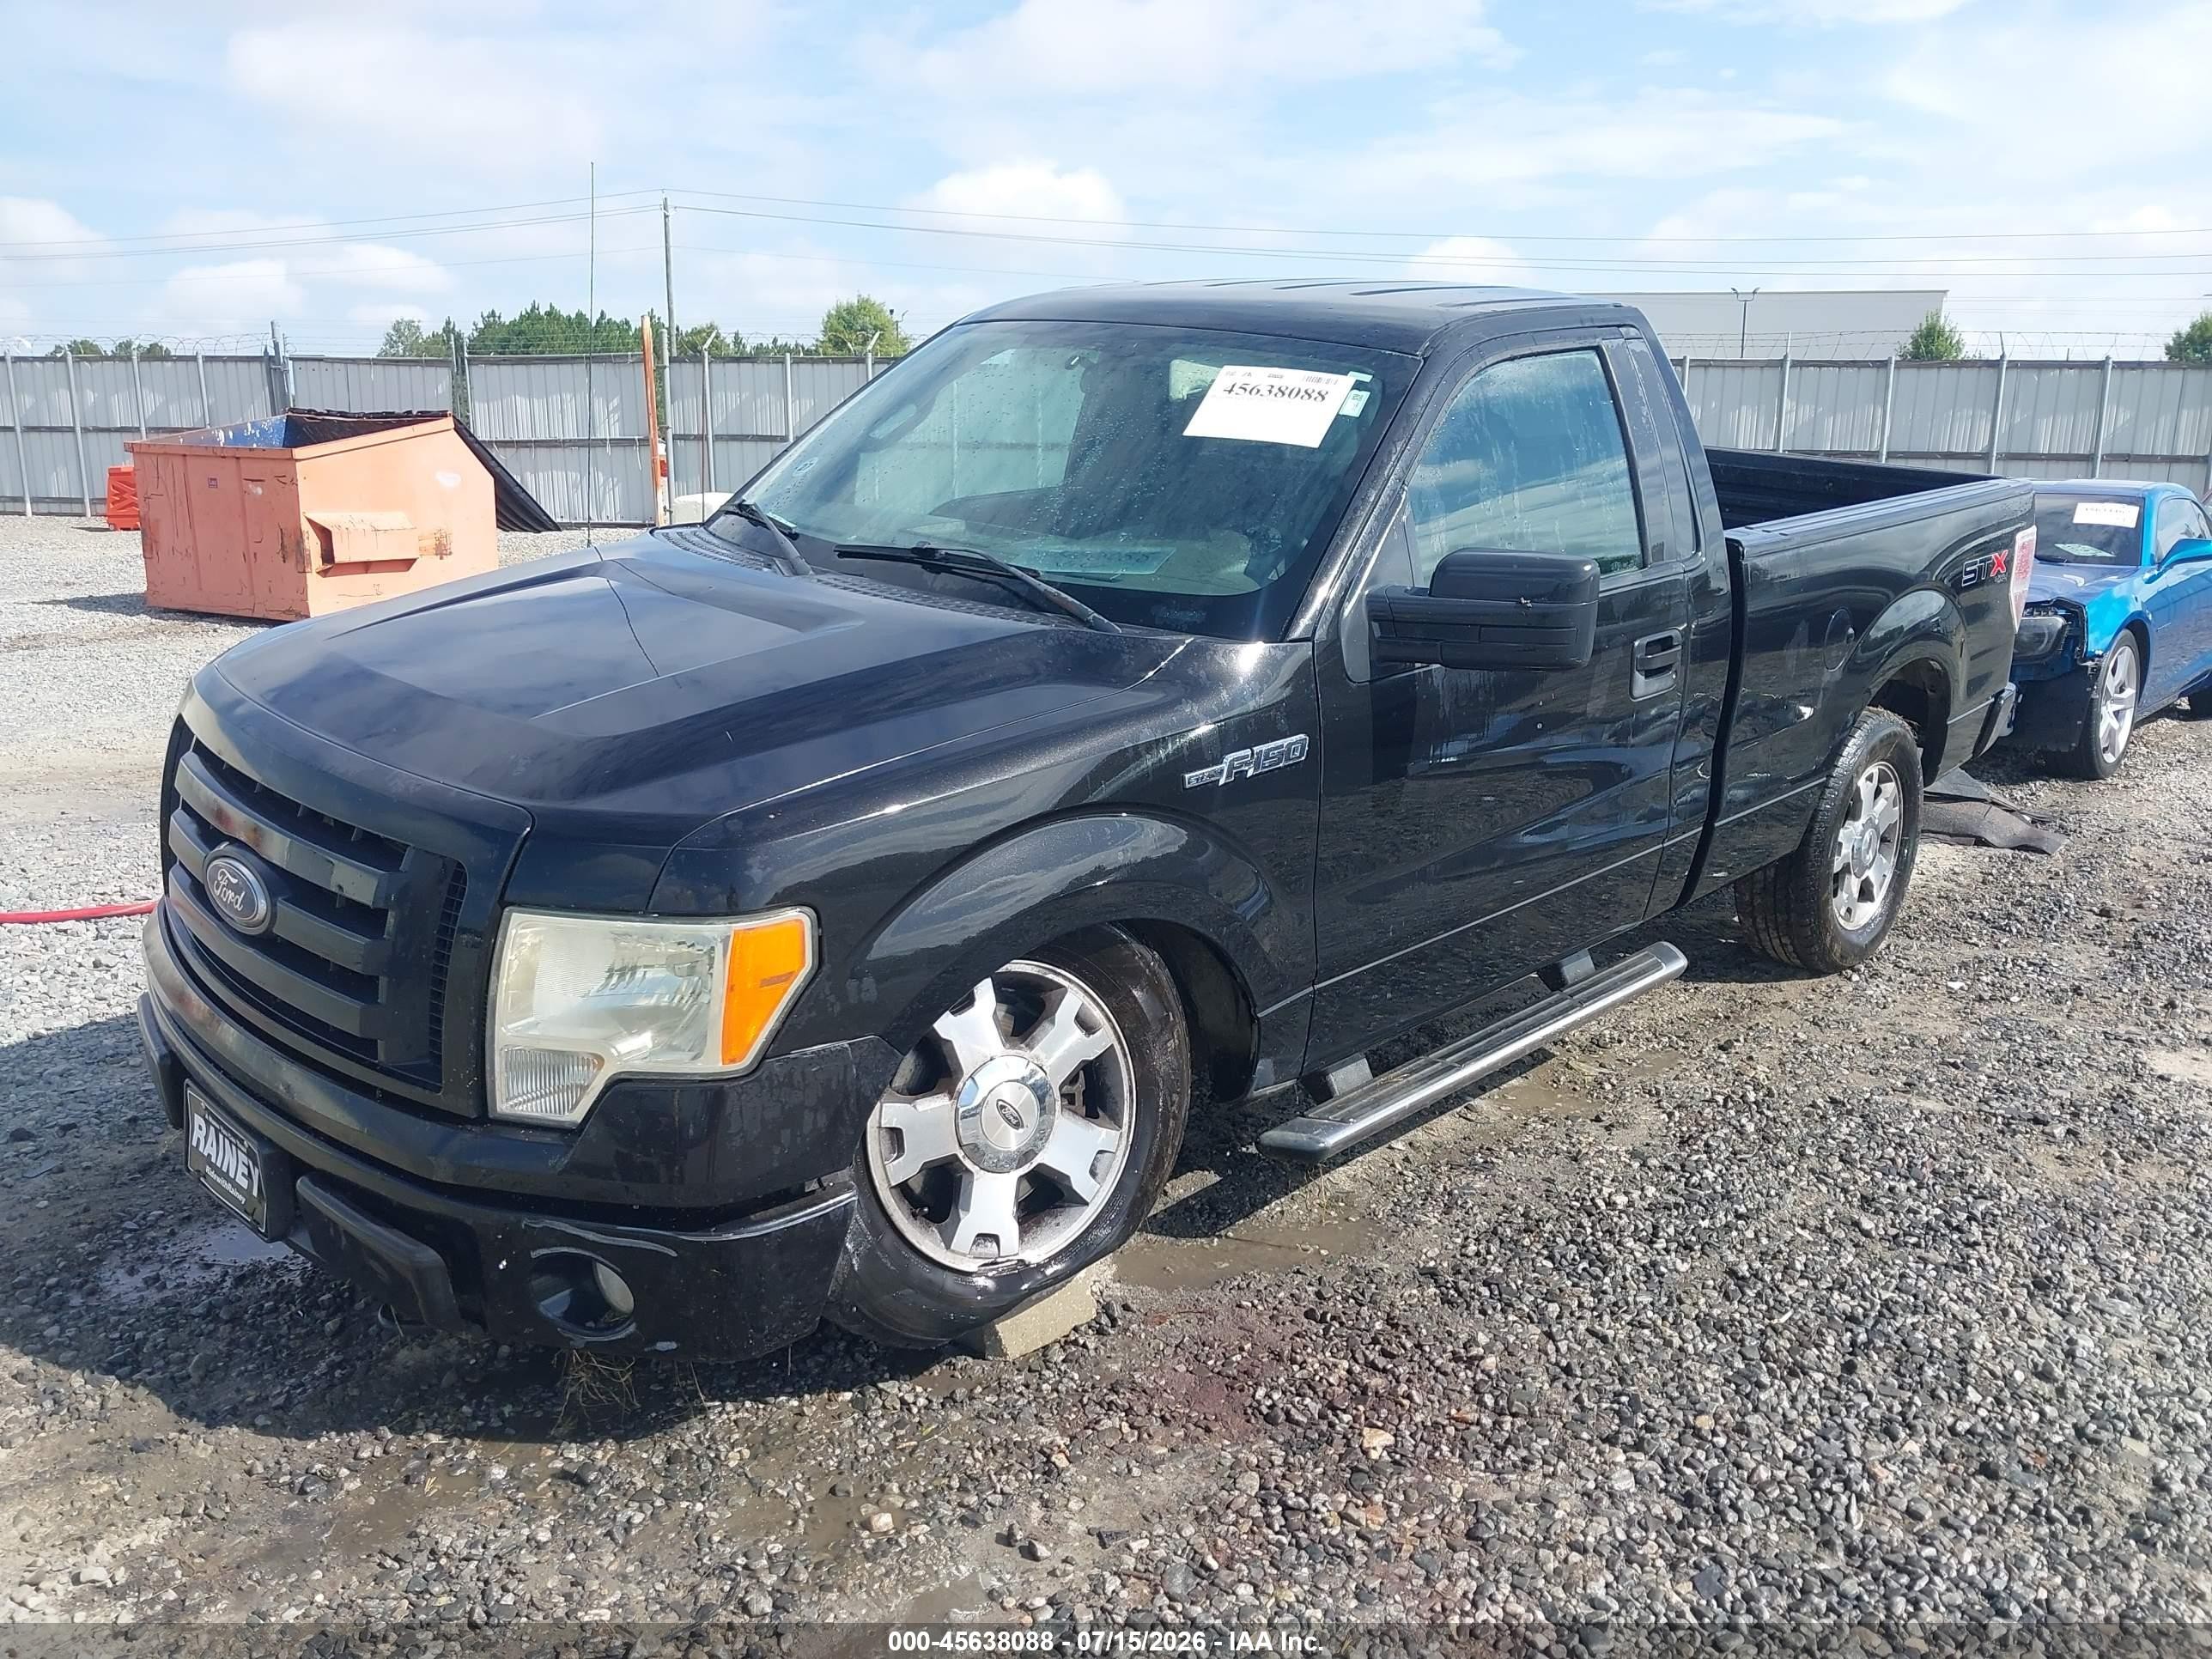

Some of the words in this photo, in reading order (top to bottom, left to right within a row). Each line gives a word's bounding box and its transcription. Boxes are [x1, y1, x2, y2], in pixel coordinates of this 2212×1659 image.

[1223, 382, 1329, 402] 45638088
[1961, 550, 2008, 587] STX
[213, 868, 246, 911] Ford
[1001, 1107, 1019, 1125] Ford
[191, 1113, 259, 1198] RAINEY
